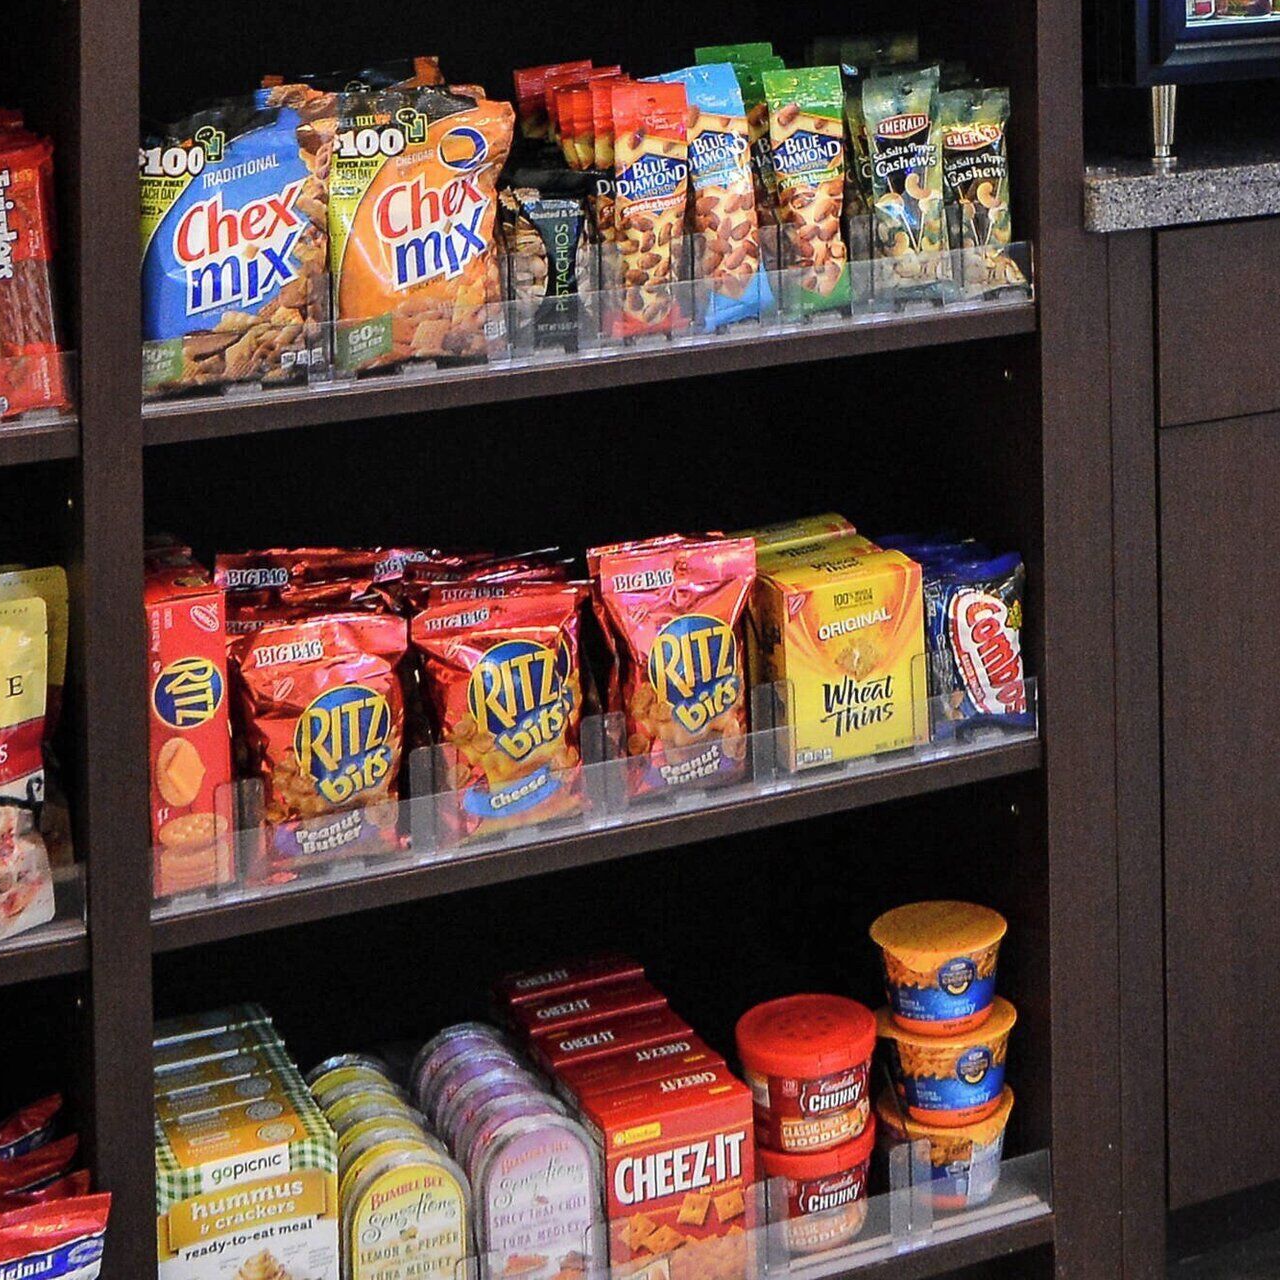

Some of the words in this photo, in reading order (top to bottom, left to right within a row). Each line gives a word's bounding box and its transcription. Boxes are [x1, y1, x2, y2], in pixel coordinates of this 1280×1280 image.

[880, 116, 924, 134] EMERALD
[773, 140, 841, 171] DIAMOND
[785, 135, 820, 157] BLUE
[202, 157, 279, 190] TRADITIONAL
[617, 164, 686, 196] DIAMOND
[632, 159, 669, 179] BLUE
[875, 155, 937, 176] Cashews
[176, 184, 304, 262] Chex
[379, 174, 485, 240] Chex
[397, 206, 487, 286] mix
[189, 232, 297, 311] mix
[555, 223, 569, 313] PISTACHIOS
[613, 574, 643, 592] BIG
[644, 569, 673, 588] BAG
[818, 607, 892, 643] ORIGINAL
[256, 645, 289, 667] BIG
[652, 625, 736, 705] RITZ
[165, 658, 216, 725] RITZ
[822, 675, 893, 713] Wheat
[299, 695, 387, 780] RITZ
[820, 702, 893, 740] Thins
[320, 746, 393, 805] bits
[295, 810, 362, 844] Peanut
[809, 1082, 862, 1112] CHUNKY
[211, 1153, 282, 1185] gopicnic
[614, 1132, 746, 1206] CHEEZ-IT
[190, 1180, 304, 1222] hummus
[808, 1181, 860, 1212] CHUNKY
[212, 1201, 296, 1232] crackers
[184, 1228, 280, 1261] ready-to-eat
